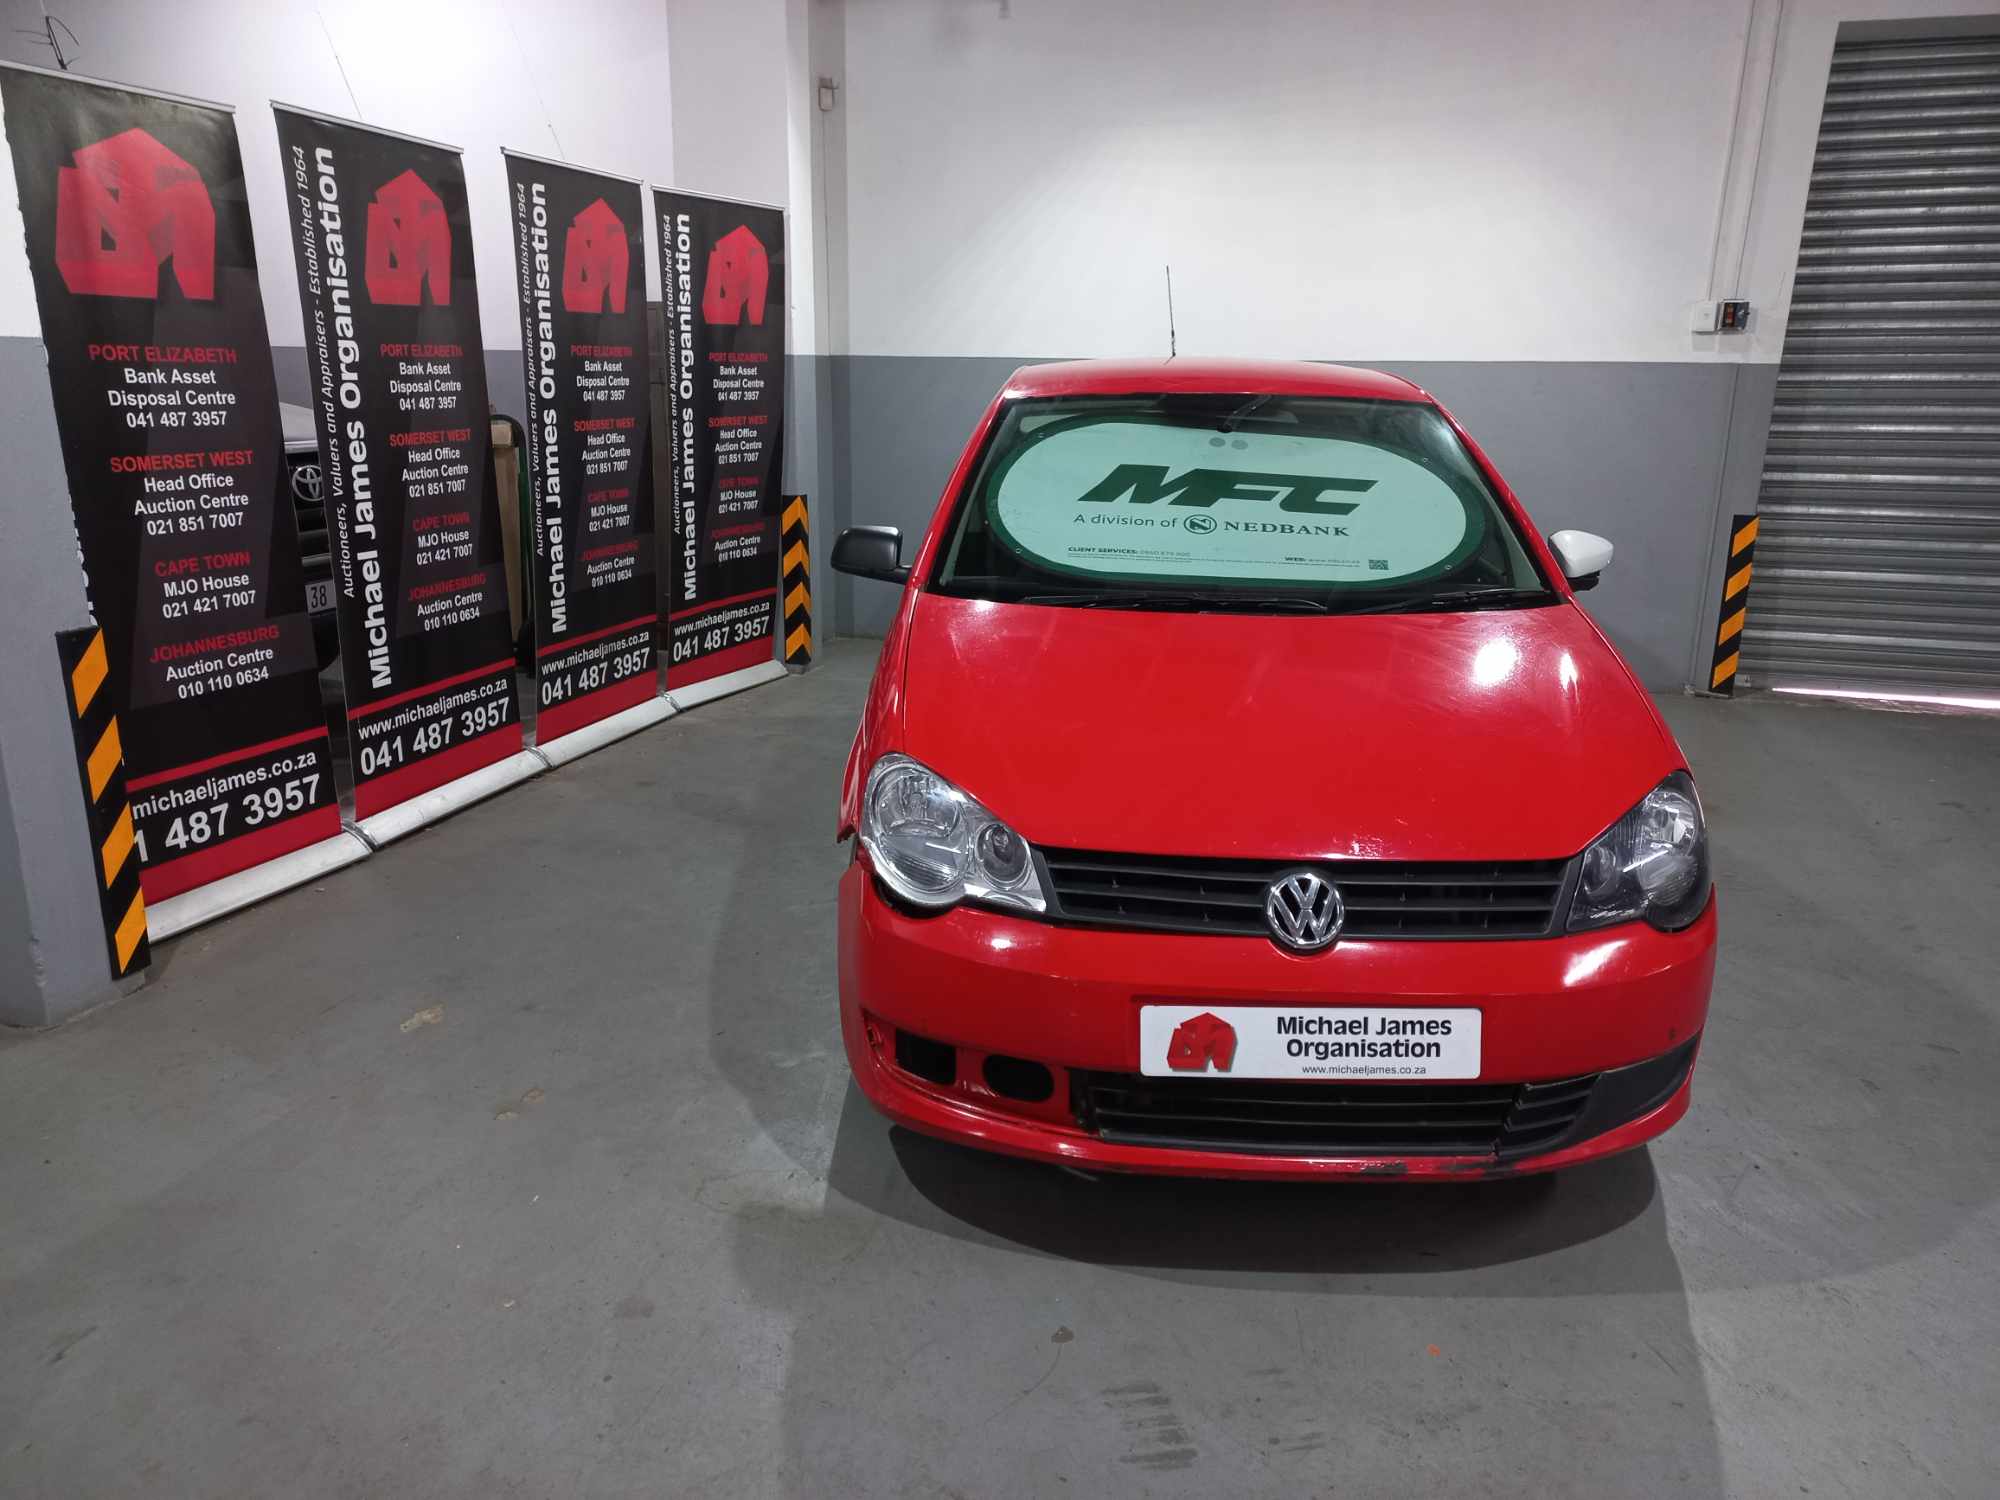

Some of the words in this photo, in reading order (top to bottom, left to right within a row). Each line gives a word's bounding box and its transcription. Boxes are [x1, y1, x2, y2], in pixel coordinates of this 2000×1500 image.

[292, 145, 309, 191] 1964
[299, 194, 321, 295] Established
[519, 221, 530, 304] Established
[315, 147, 361, 409] Organisation
[531, 182, 556, 400] Organisation
[675, 213, 694, 400] Organisation
[88, 344, 139, 361] PORT
[145, 346, 237, 364] ELIZABETH
[315, 309, 334, 399] Appraisers
[527, 317, 536, 389] Appraisers
[124, 368, 166, 384] Bank
[171, 369, 216, 384] Asset
[400, 362, 424, 375] Bank
[427, 362, 451, 375] Asset
[584, 361, 601, 372] Bank
[603, 361, 622, 372] Asset
[738, 366, 757, 375] Asset
[390, 380, 432, 394] Disposal
[434, 380, 462, 392] Centre
[576, 376, 606, 387] Disposal
[608, 376, 629, 387] Centre
[742, 379, 764, 388] Centre
[108, 390, 181, 409] Disposal
[186, 391, 235, 405] Centre
[400, 398, 416, 411] 041
[419, 398, 435, 409] 487
[438, 396, 457, 409] 3957
[529, 391, 537, 418] and
[126, 412, 155, 428] 041
[160, 412, 188, 427] 487
[192, 411, 227, 426] 3957
[323, 401, 337, 433] and
[389, 431, 445, 447] SOMERSET
[448, 428, 471, 441] WEST
[588, 434, 604, 446] Head
[606, 433, 625, 444] Office
[737, 428, 757, 438] Office
[408, 450, 432, 463] Head
[435, 448, 461, 460] Office
[531, 423, 541, 472] Valuers
[544, 408, 562, 508] James
[582, 449, 608, 461] Auction
[609, 447, 630, 458] Centre
[683, 407, 695, 493] James
[111, 453, 205, 473] SOMERSET
[211, 450, 253, 466] WEST
[328, 438, 344, 497] Valuers
[402, 467, 439, 482] Auction
[441, 464, 469, 477] Centre
[144, 477, 186, 493] Head
[189, 473, 234, 490] Office
[347, 420, 377, 540] James
[409, 485, 425, 498] 021
[428, 483, 444, 495] 851
[447, 479, 466, 493] 7007
[1077, 463, 1379, 516] MFC
[134, 498, 195, 516] Auction
[199, 493, 249, 510] Centre
[607, 503, 628, 514] House
[147, 520, 174, 536] 021
[179, 516, 205, 532] 851
[209, 512, 243, 529] 7007
[1073, 514, 1085, 523] A
[1091, 514, 1154, 527] division
[1160, 518, 1178, 528] of
[1224, 521, 1350, 537] NEDBANK
[337, 503, 355, 598] Auctioneers,
[418, 534, 439, 548] MJO
[441, 531, 470, 544] House
[683, 501, 696, 600] Michael
[155, 560, 199, 577] CAPE
[203, 552, 251, 570] TOWN
[417, 552, 433, 565] 021
[435, 548, 451, 561] 421
[453, 544, 473, 558] 7007
[587, 560, 612, 575] Auction
[613, 555, 635, 569] Centre
[164, 579, 198, 598] MJO
[202, 574, 250, 591] House
[546, 517, 566, 633] Michael
[162, 602, 188, 619] 021
[193, 598, 218, 614] 421
[222, 591, 256, 608] 7007
[311, 587, 328, 607] 38
[417, 599, 452, 617] Auction
[454, 591, 483, 608] Centre
[357, 550, 392, 689] Michael
[424, 616, 440, 632] 010
[442, 611, 457, 627] 110
[460, 607, 480, 623] 0634
[674, 601, 770, 636] www.michaeljames.co.za
[150, 625, 279, 663] JOHANNESBURG
[673, 635, 699, 662] 041
[704, 626, 730, 651] 487
[734, 615, 770, 643] 3957
[165, 659, 225, 681] Auction
[227, 648, 274, 668] Centre
[542, 630, 649, 676] www.michaeljames.co.za
[178, 683, 204, 699] 010
[207, 675, 233, 692] 110
[236, 666, 269, 685] 0634
[542, 674, 572, 706] 041
[578, 661, 608, 691] 487
[613, 647, 650, 680] 3957
[358, 678, 508, 740] www.michaeljames.co.za
[360, 735, 404, 776] 041
[412, 717, 454, 755] 487
[462, 697, 510, 736] 3957
[133, 751, 317, 820] michaeljames.co.za
[165, 803, 229, 849] 487
[242, 773, 320, 825] 3957
[1276, 1016, 1369, 1036] Michael
[1375, 1016, 1452, 1036] James
[1286, 1038, 1441, 1061] Organisation
[1302, 1065, 1426, 1076] www.michaeljames.co.za
